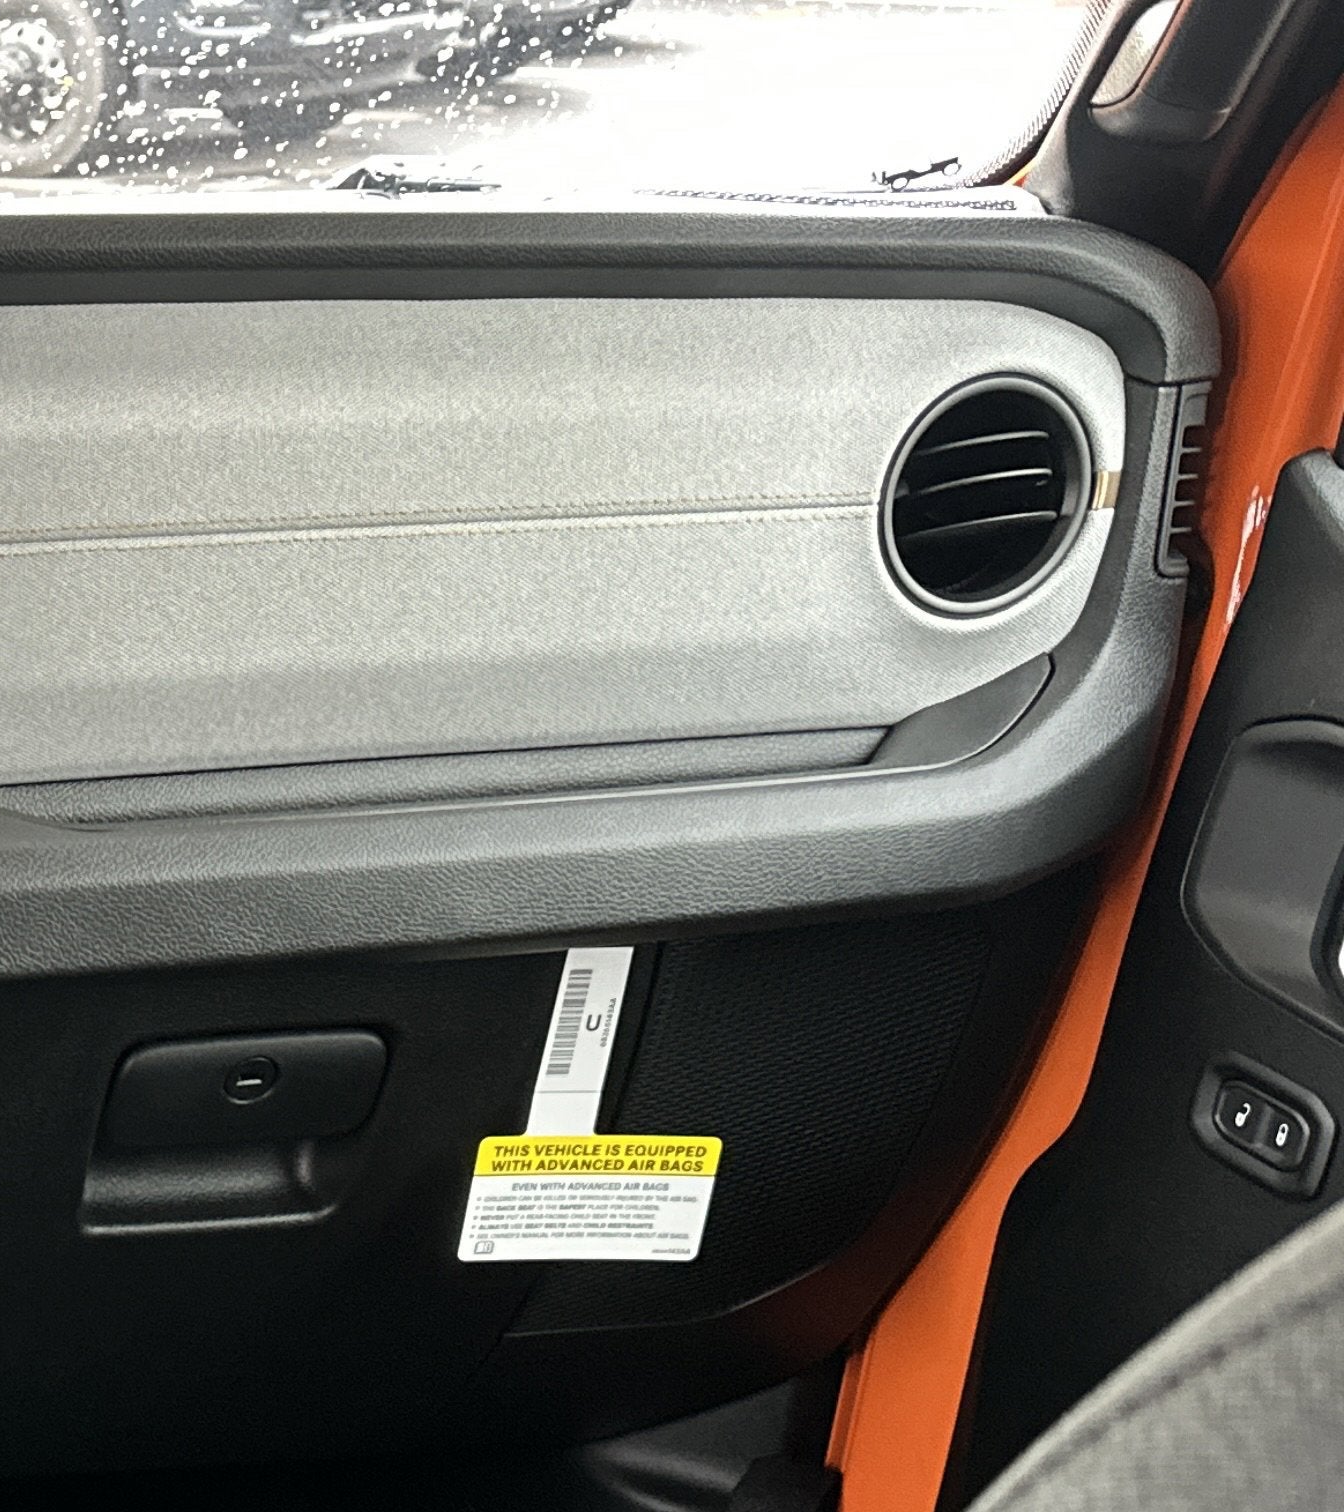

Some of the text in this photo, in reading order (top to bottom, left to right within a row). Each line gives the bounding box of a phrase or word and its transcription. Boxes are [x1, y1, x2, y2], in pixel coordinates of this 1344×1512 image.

[585, 1013, 602, 1032] U
[494, 1145, 707, 1158] THIS VEHICLE IS EQUIPPED
[491, 1159, 704, 1172] WITH ADVANCED AIR BAGS
[512, 1183, 670, 1192] EVEN WITH ADVANCED AIR BAGS
